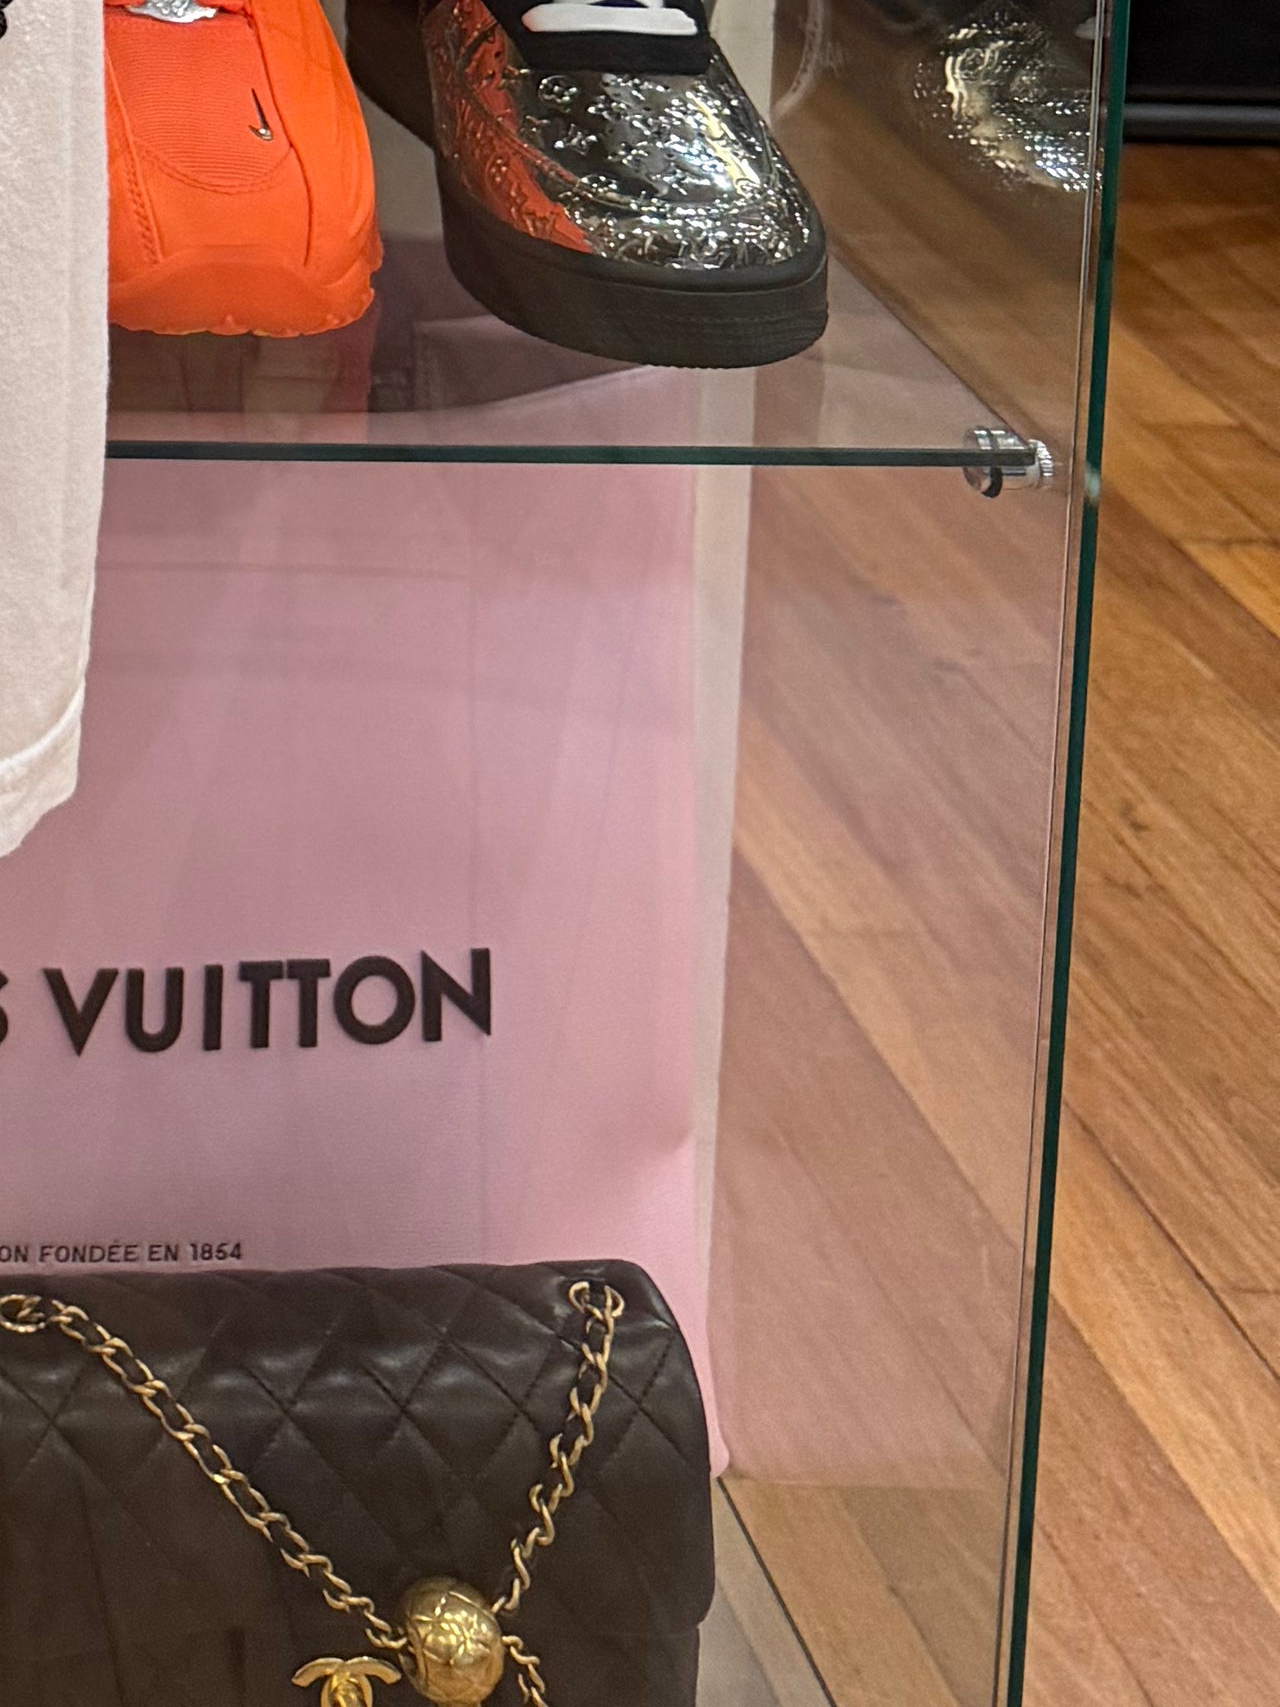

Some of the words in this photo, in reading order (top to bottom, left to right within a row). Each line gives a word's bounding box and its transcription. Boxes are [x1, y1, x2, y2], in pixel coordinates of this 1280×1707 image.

[43, 947, 492, 1056] VUITTON
[40, 1239, 138, 1263] FONDÉE
[148, 1243, 179, 1262] EN
